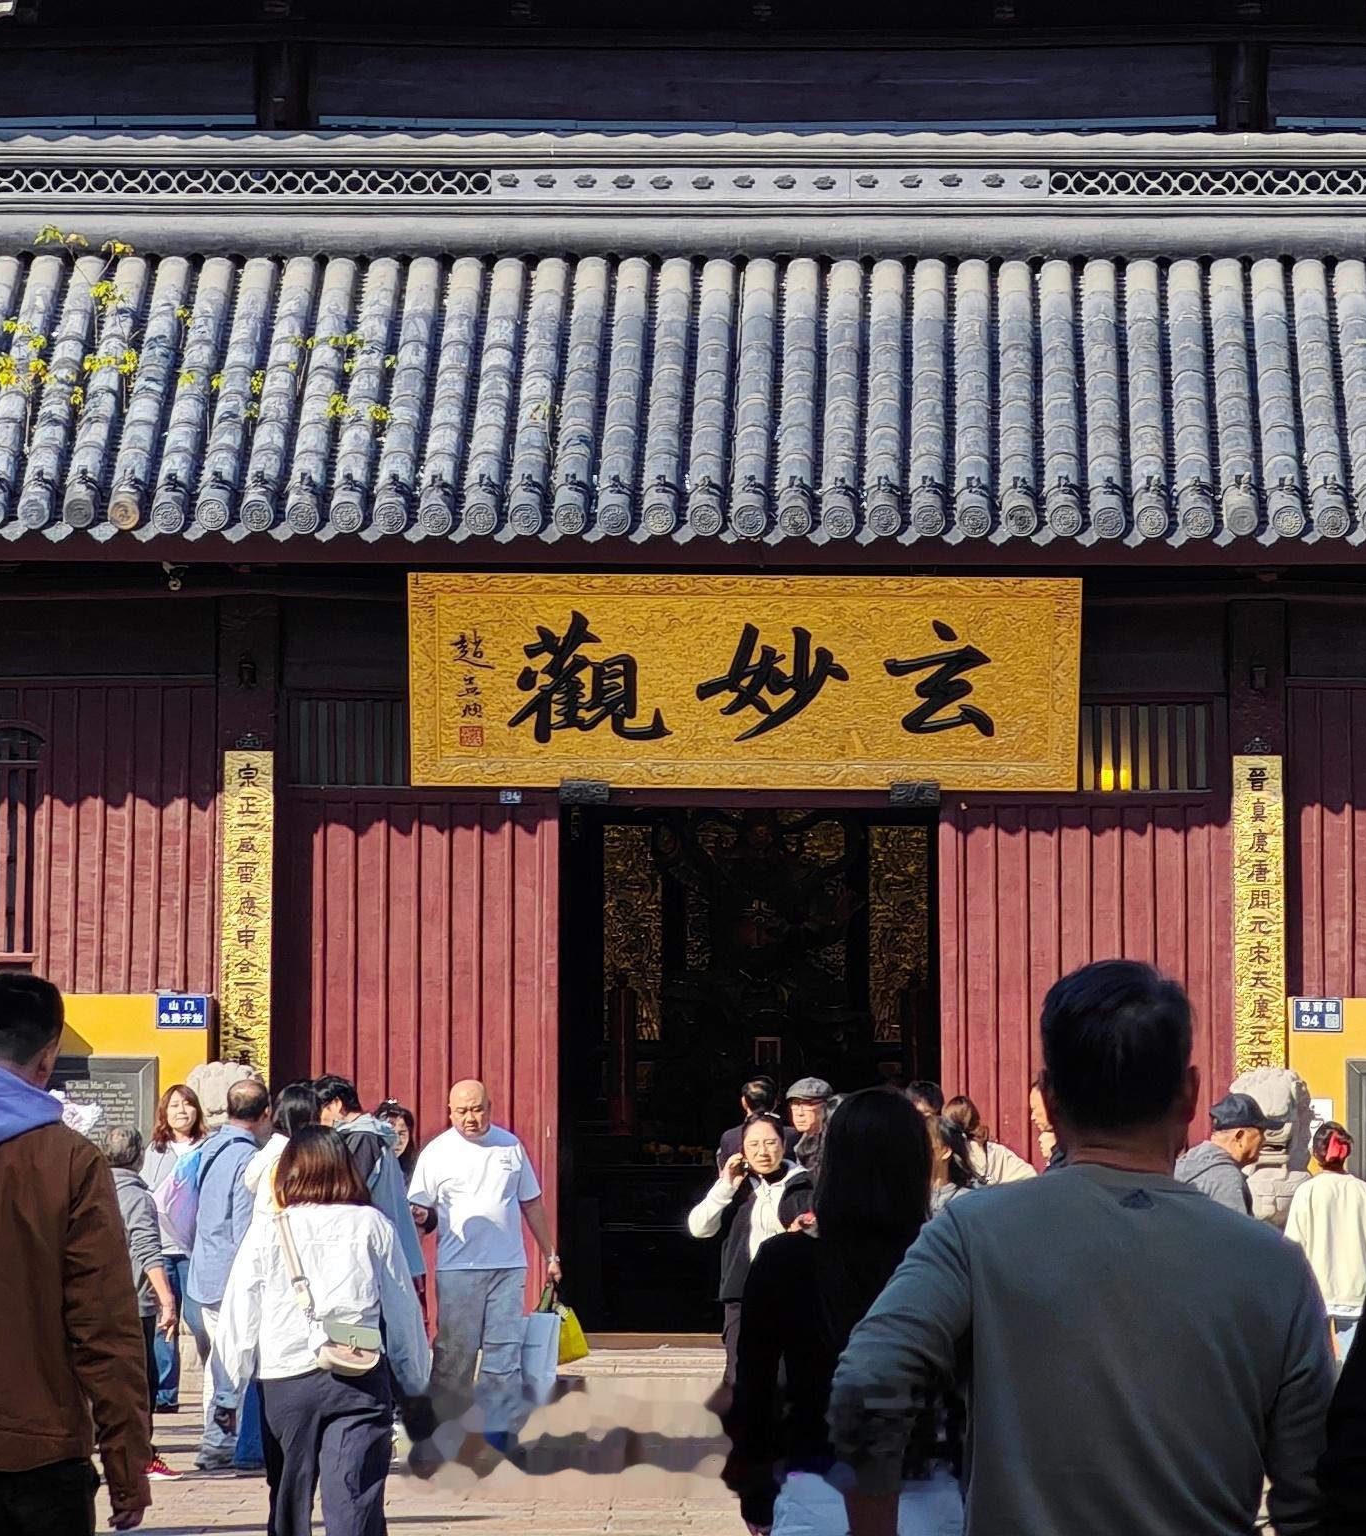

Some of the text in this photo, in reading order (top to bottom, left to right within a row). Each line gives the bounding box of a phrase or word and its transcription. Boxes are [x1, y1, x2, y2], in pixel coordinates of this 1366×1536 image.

[507, 610, 996, 744] 玄妙觀
[168, 999, 197, 1011] 山门
[160, 1012, 203, 1024] 免费开放
[1301, 1014, 1319, 1027] 94
